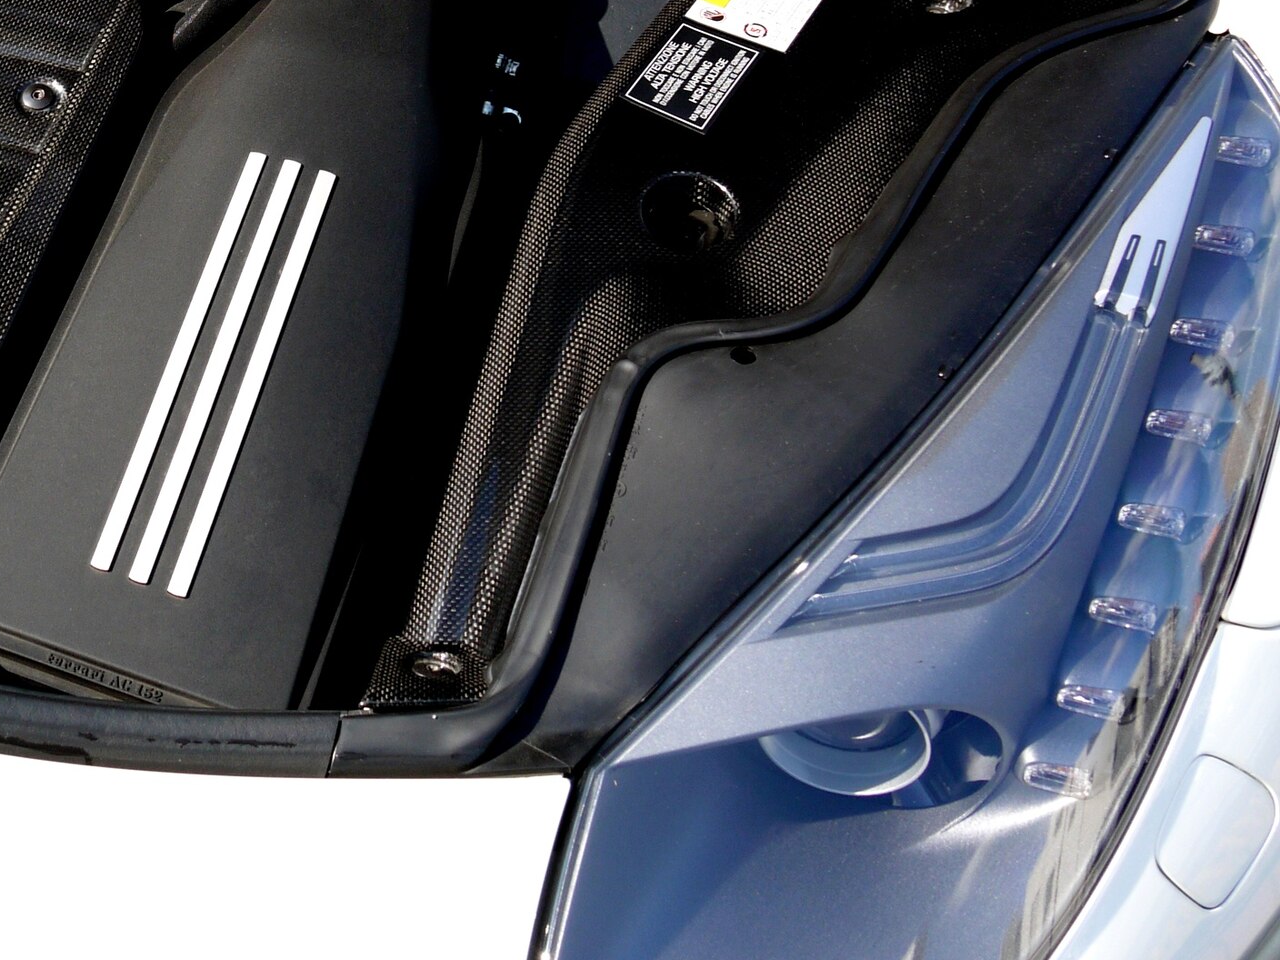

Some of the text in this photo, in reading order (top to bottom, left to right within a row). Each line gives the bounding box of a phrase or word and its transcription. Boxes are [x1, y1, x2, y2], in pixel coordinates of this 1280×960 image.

[644, 41, 680, 81] ATTENZIONE
[650, 73, 668, 89] ALTA
[661, 42, 692, 73] TENSIONE
[683, 60, 713, 91] WARNING
[688, 85, 708, 103] HIGH
[701, 57, 729, 85] VOLTAGE
[47, 652, 164, 704] Ferrari AC 152
